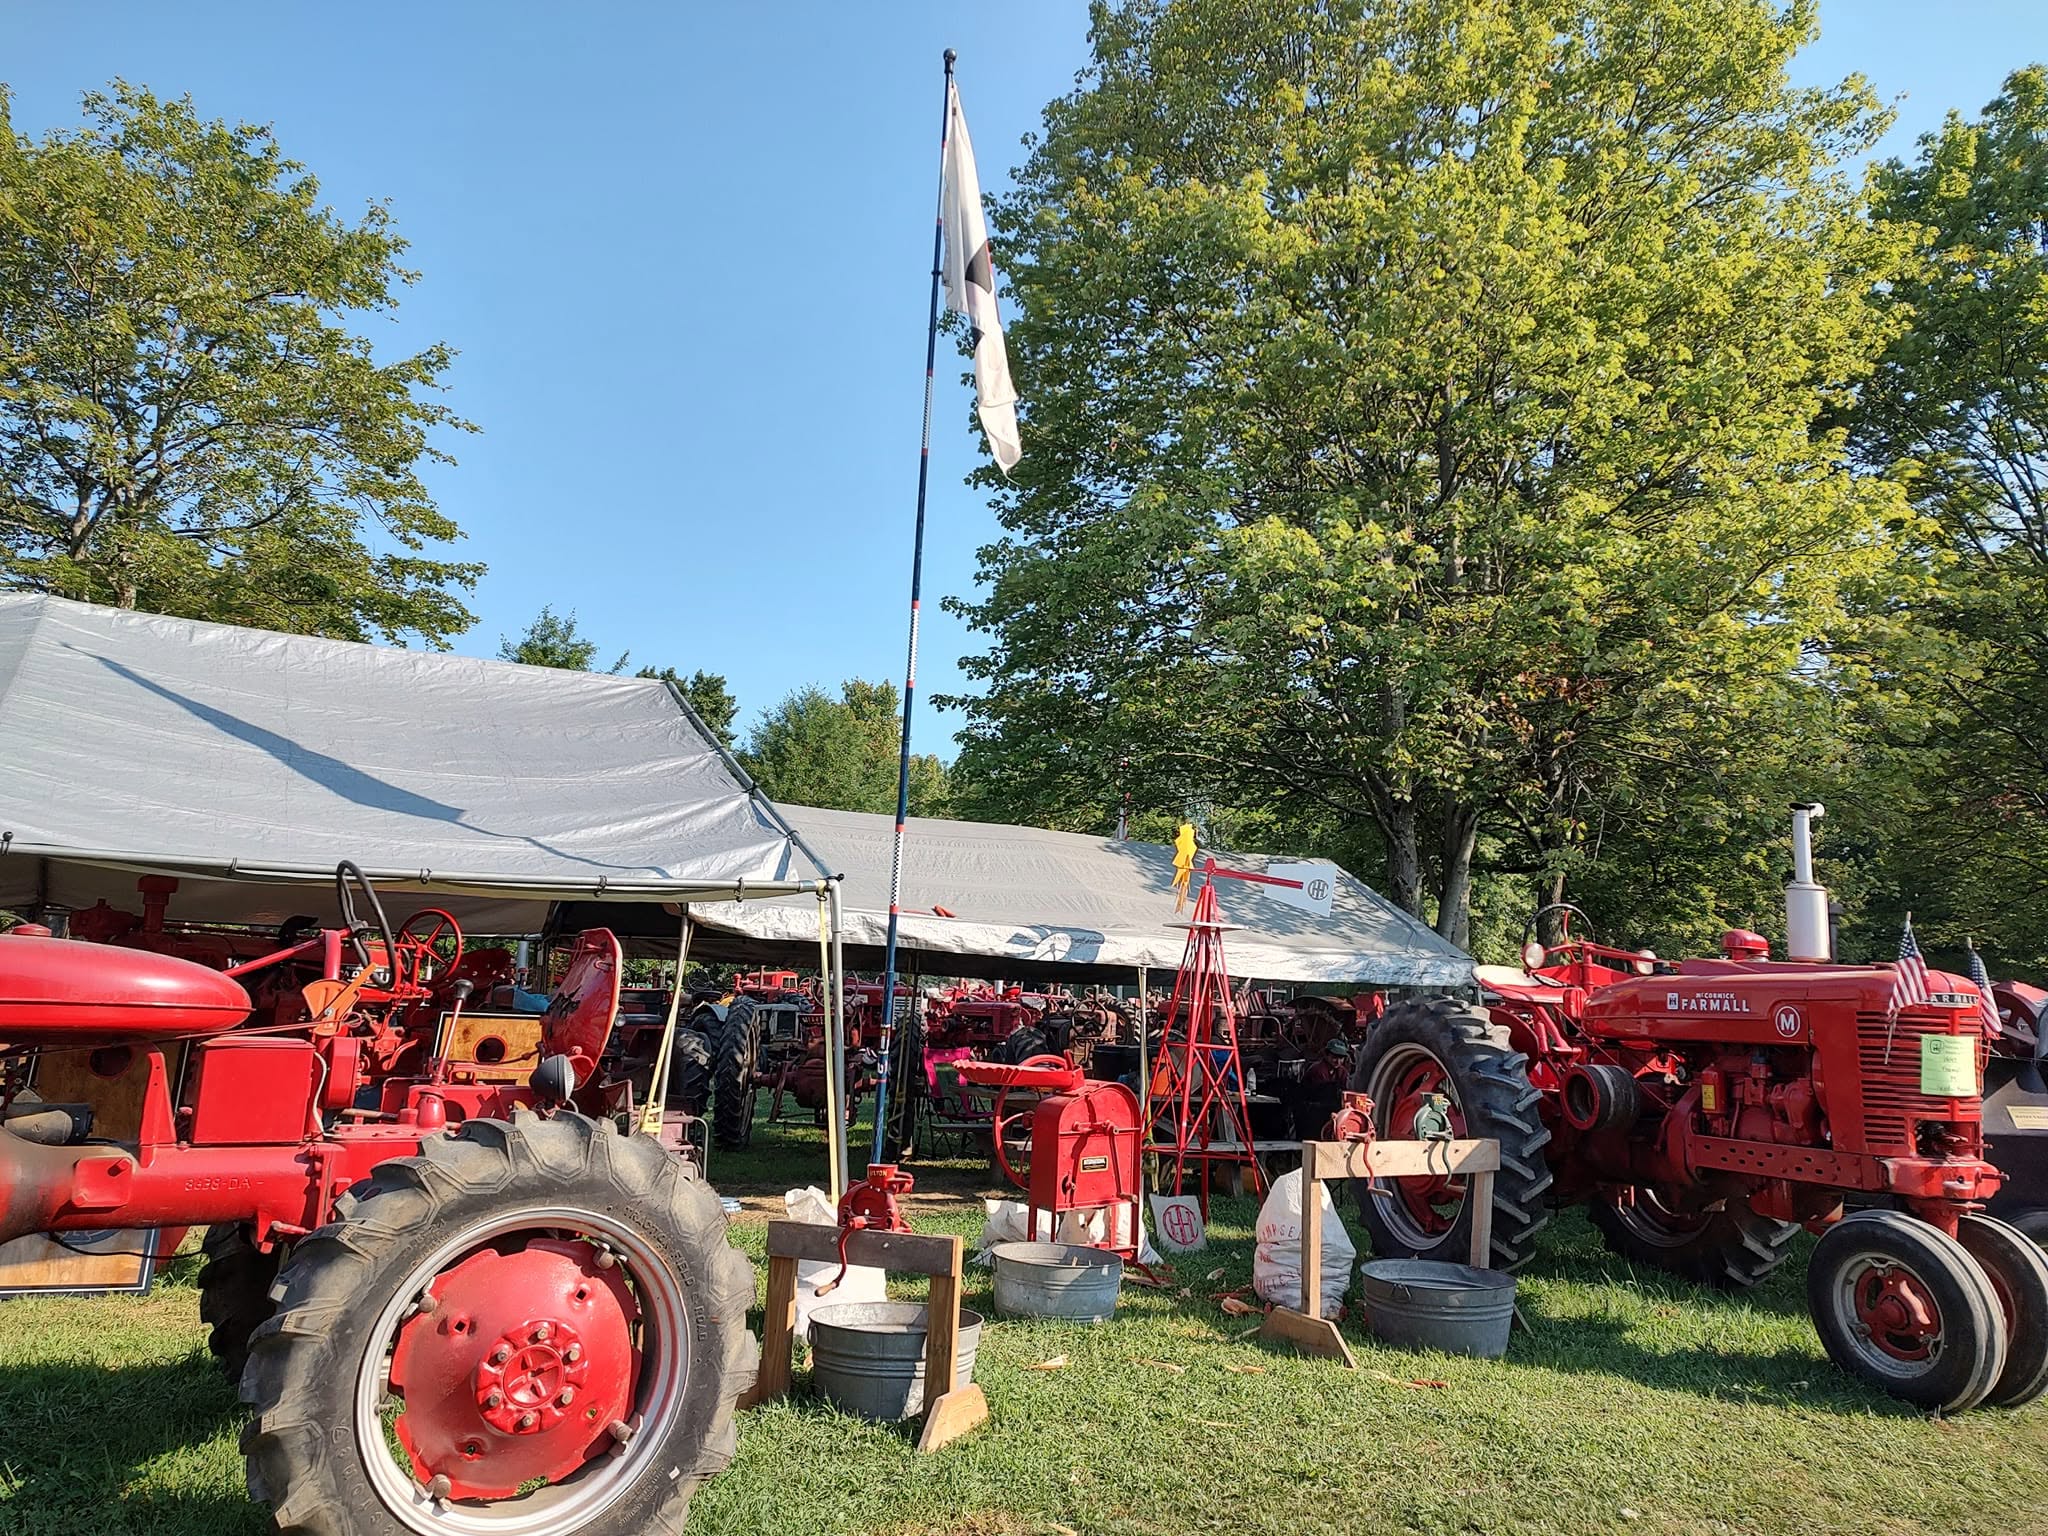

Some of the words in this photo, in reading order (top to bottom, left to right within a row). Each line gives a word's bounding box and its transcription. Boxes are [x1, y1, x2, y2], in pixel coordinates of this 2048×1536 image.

[1681, 999, 1750, 1012] FARMALL
[1780, 1013, 1795, 1032] M
[670, 1252, 695, 1288] FIELD
